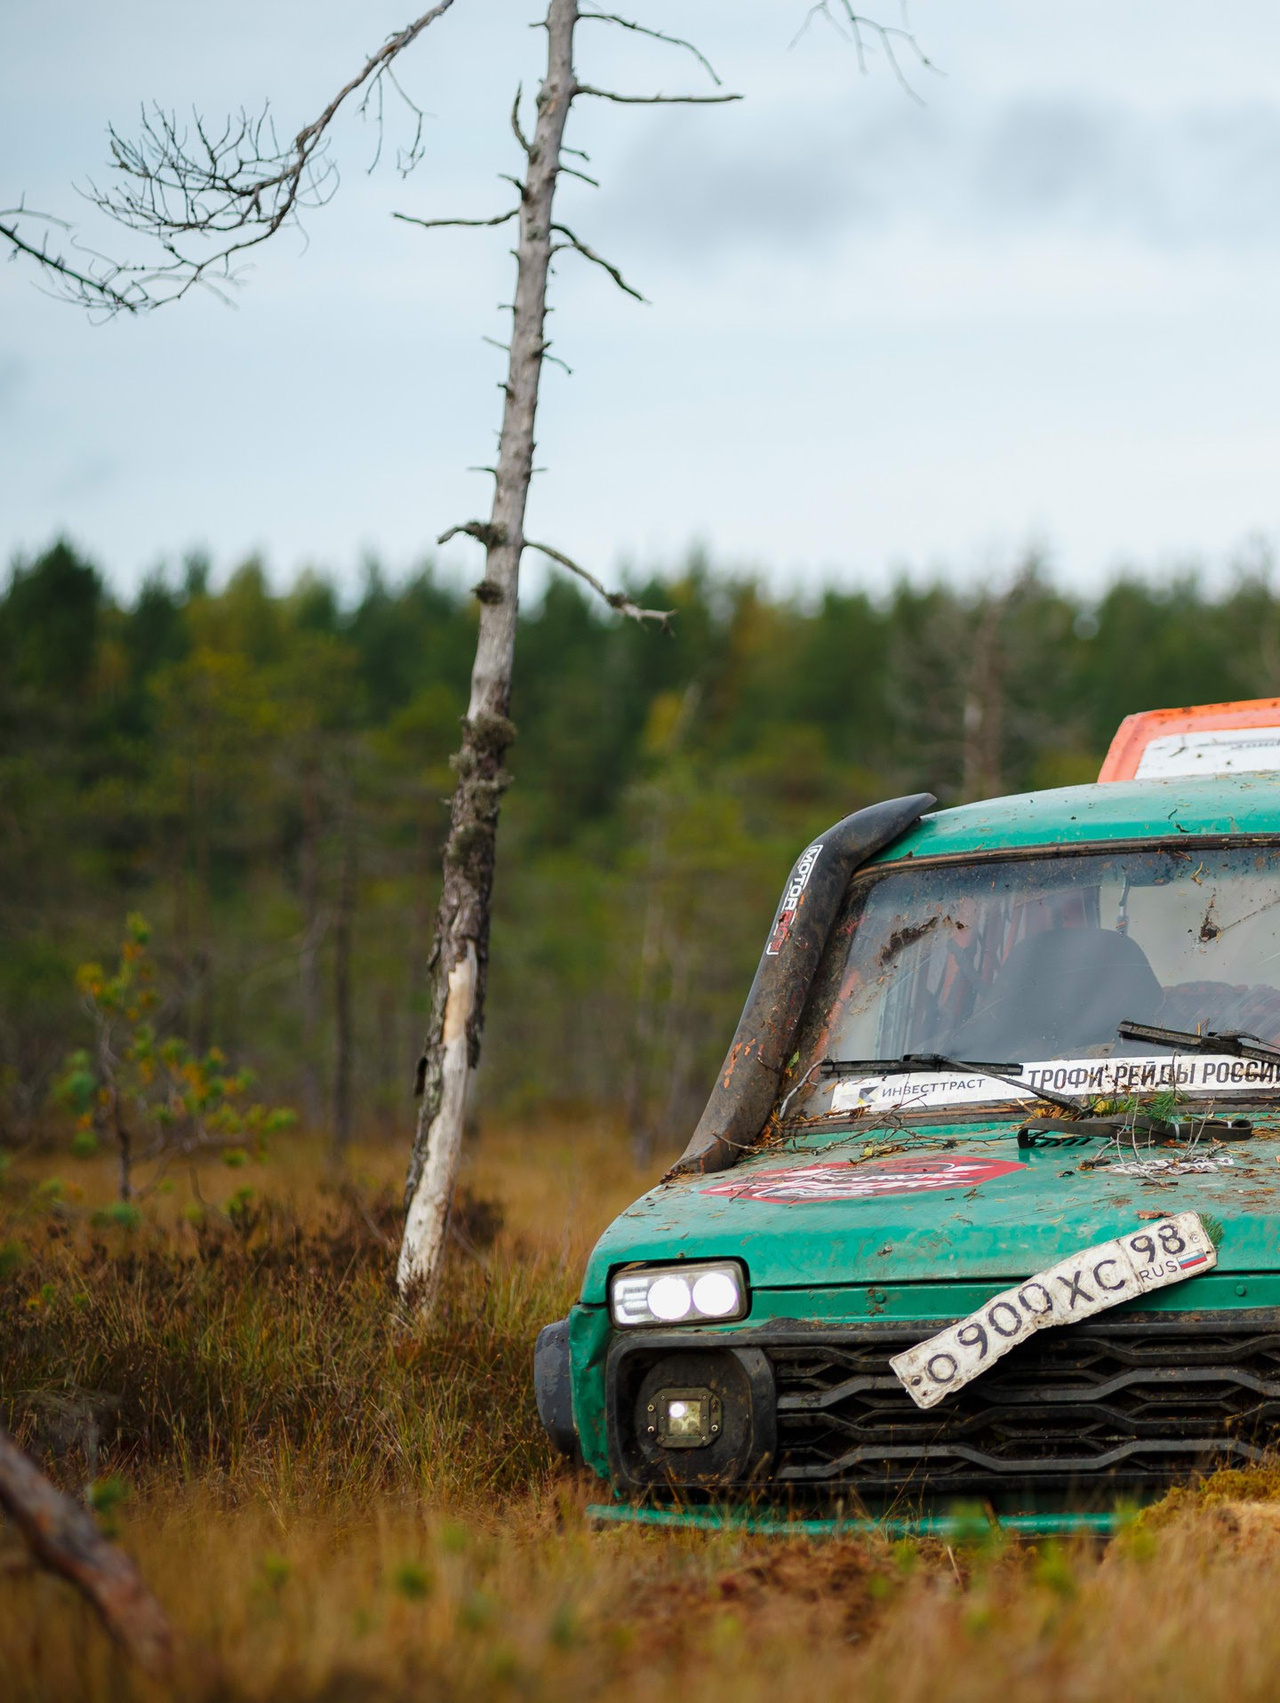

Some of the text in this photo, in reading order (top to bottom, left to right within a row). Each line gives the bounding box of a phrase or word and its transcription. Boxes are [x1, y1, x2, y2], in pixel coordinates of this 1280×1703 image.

[882, 1078, 986, 1098] ИНВЕСТТРАСТ
[1028, 1061, 1196, 1090] ТРОФИ-РЕЙДЫ
[1130, 1224, 1186, 1263] 98
[1139, 1260, 1178, 1283] RUS
